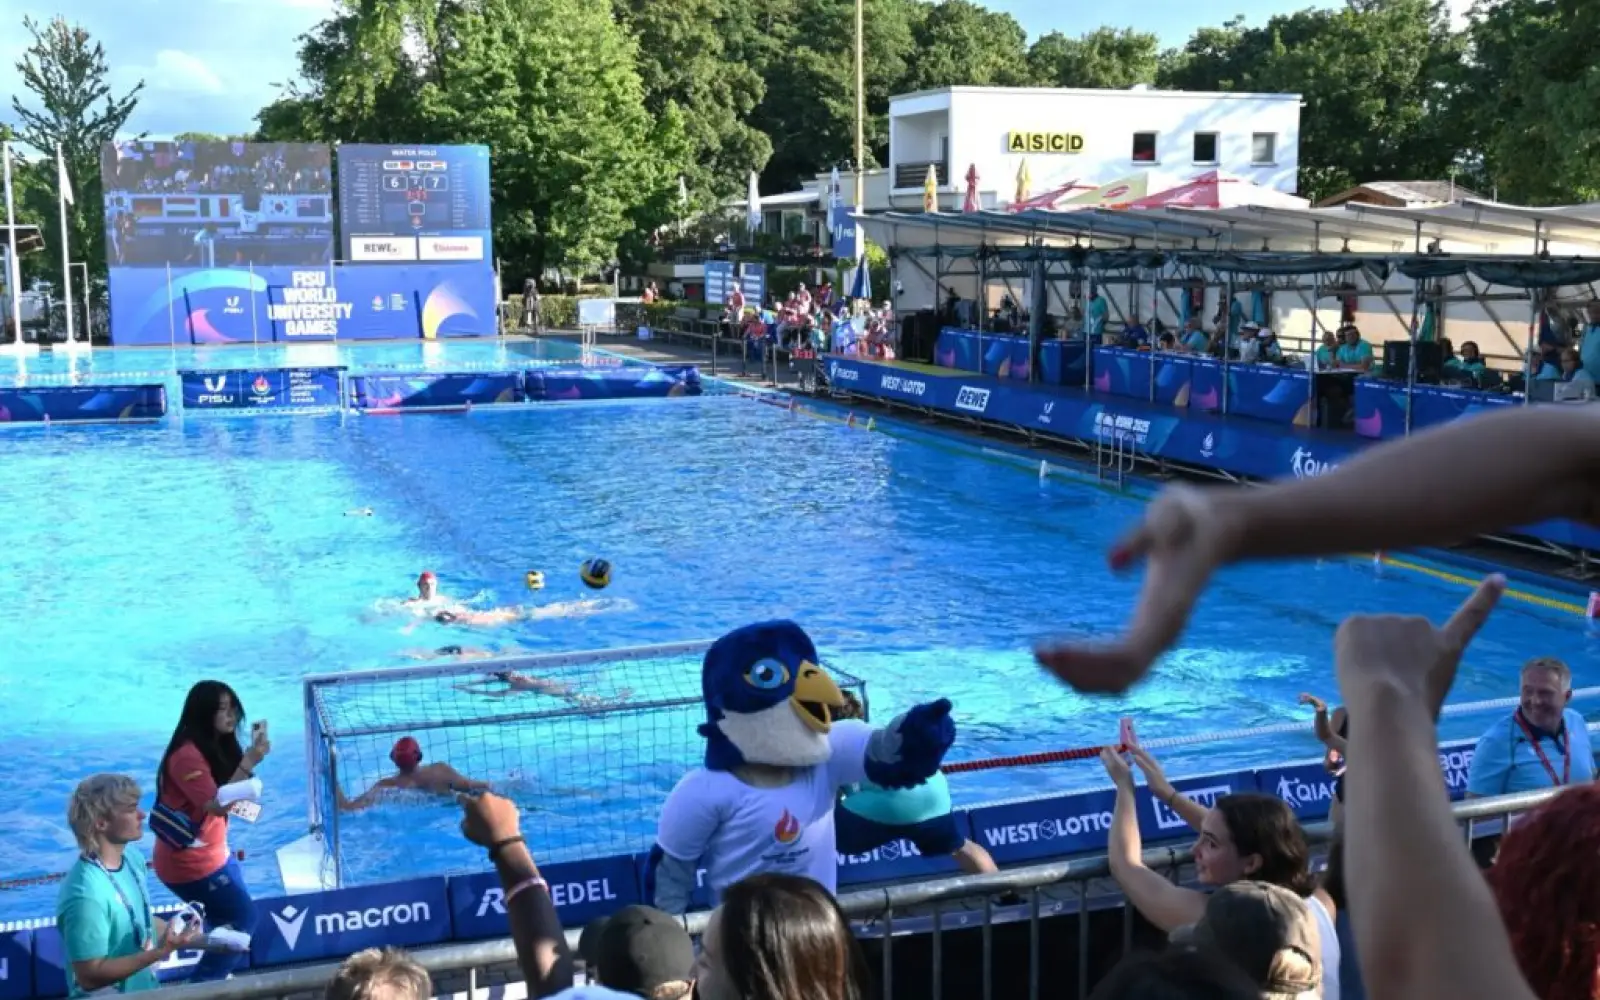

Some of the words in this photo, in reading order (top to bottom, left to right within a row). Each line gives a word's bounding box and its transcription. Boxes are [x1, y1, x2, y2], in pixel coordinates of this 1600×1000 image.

[1012, 134, 1084, 150] ASCD
[391, 177, 399, 188] 6
[433, 177, 440, 189] 7
[292, 271, 326, 287] FISU
[283, 287, 337, 303] WORLD
[267, 303, 353, 319] UNIVERSITY
[285, 320, 338, 335] GAMES
[959, 388, 988, 408] REWE
[315, 901, 431, 935] macron
